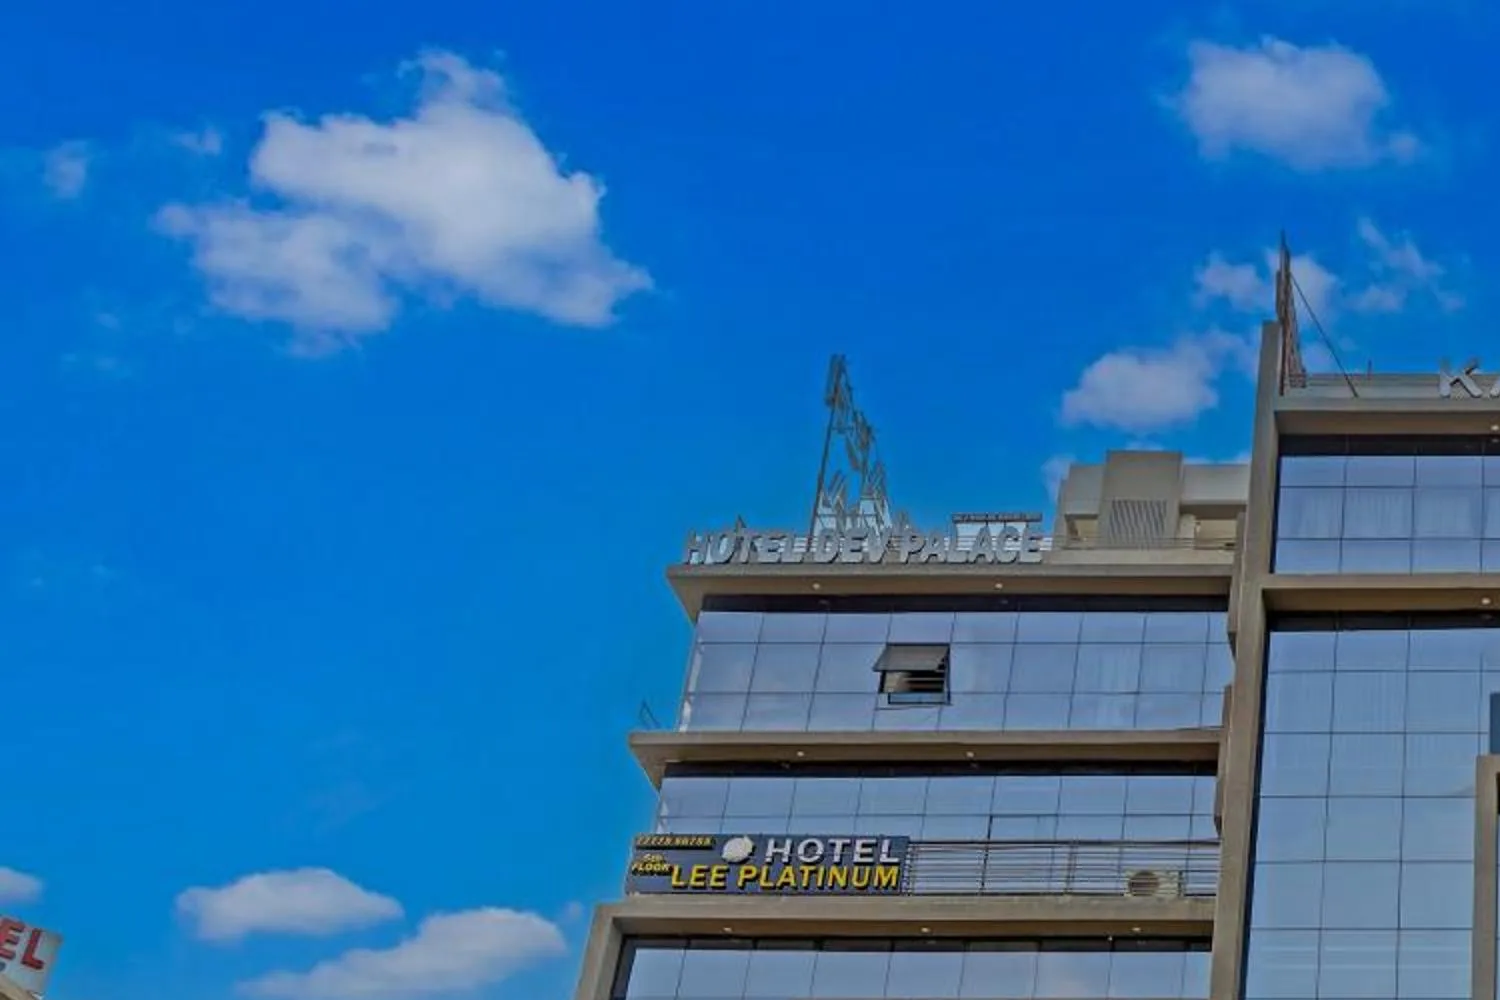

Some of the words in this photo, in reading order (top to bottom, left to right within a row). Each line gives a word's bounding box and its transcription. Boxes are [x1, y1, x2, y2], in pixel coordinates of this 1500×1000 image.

[683, 528, 804, 565] HOTEL
[813, 526, 889, 565] DEV
[900, 525, 1043, 565] PALACE
[764, 837, 900, 865] HOTEL
[670, 864, 729, 888] LEE
[737, 864, 899, 890] PLATINUM
